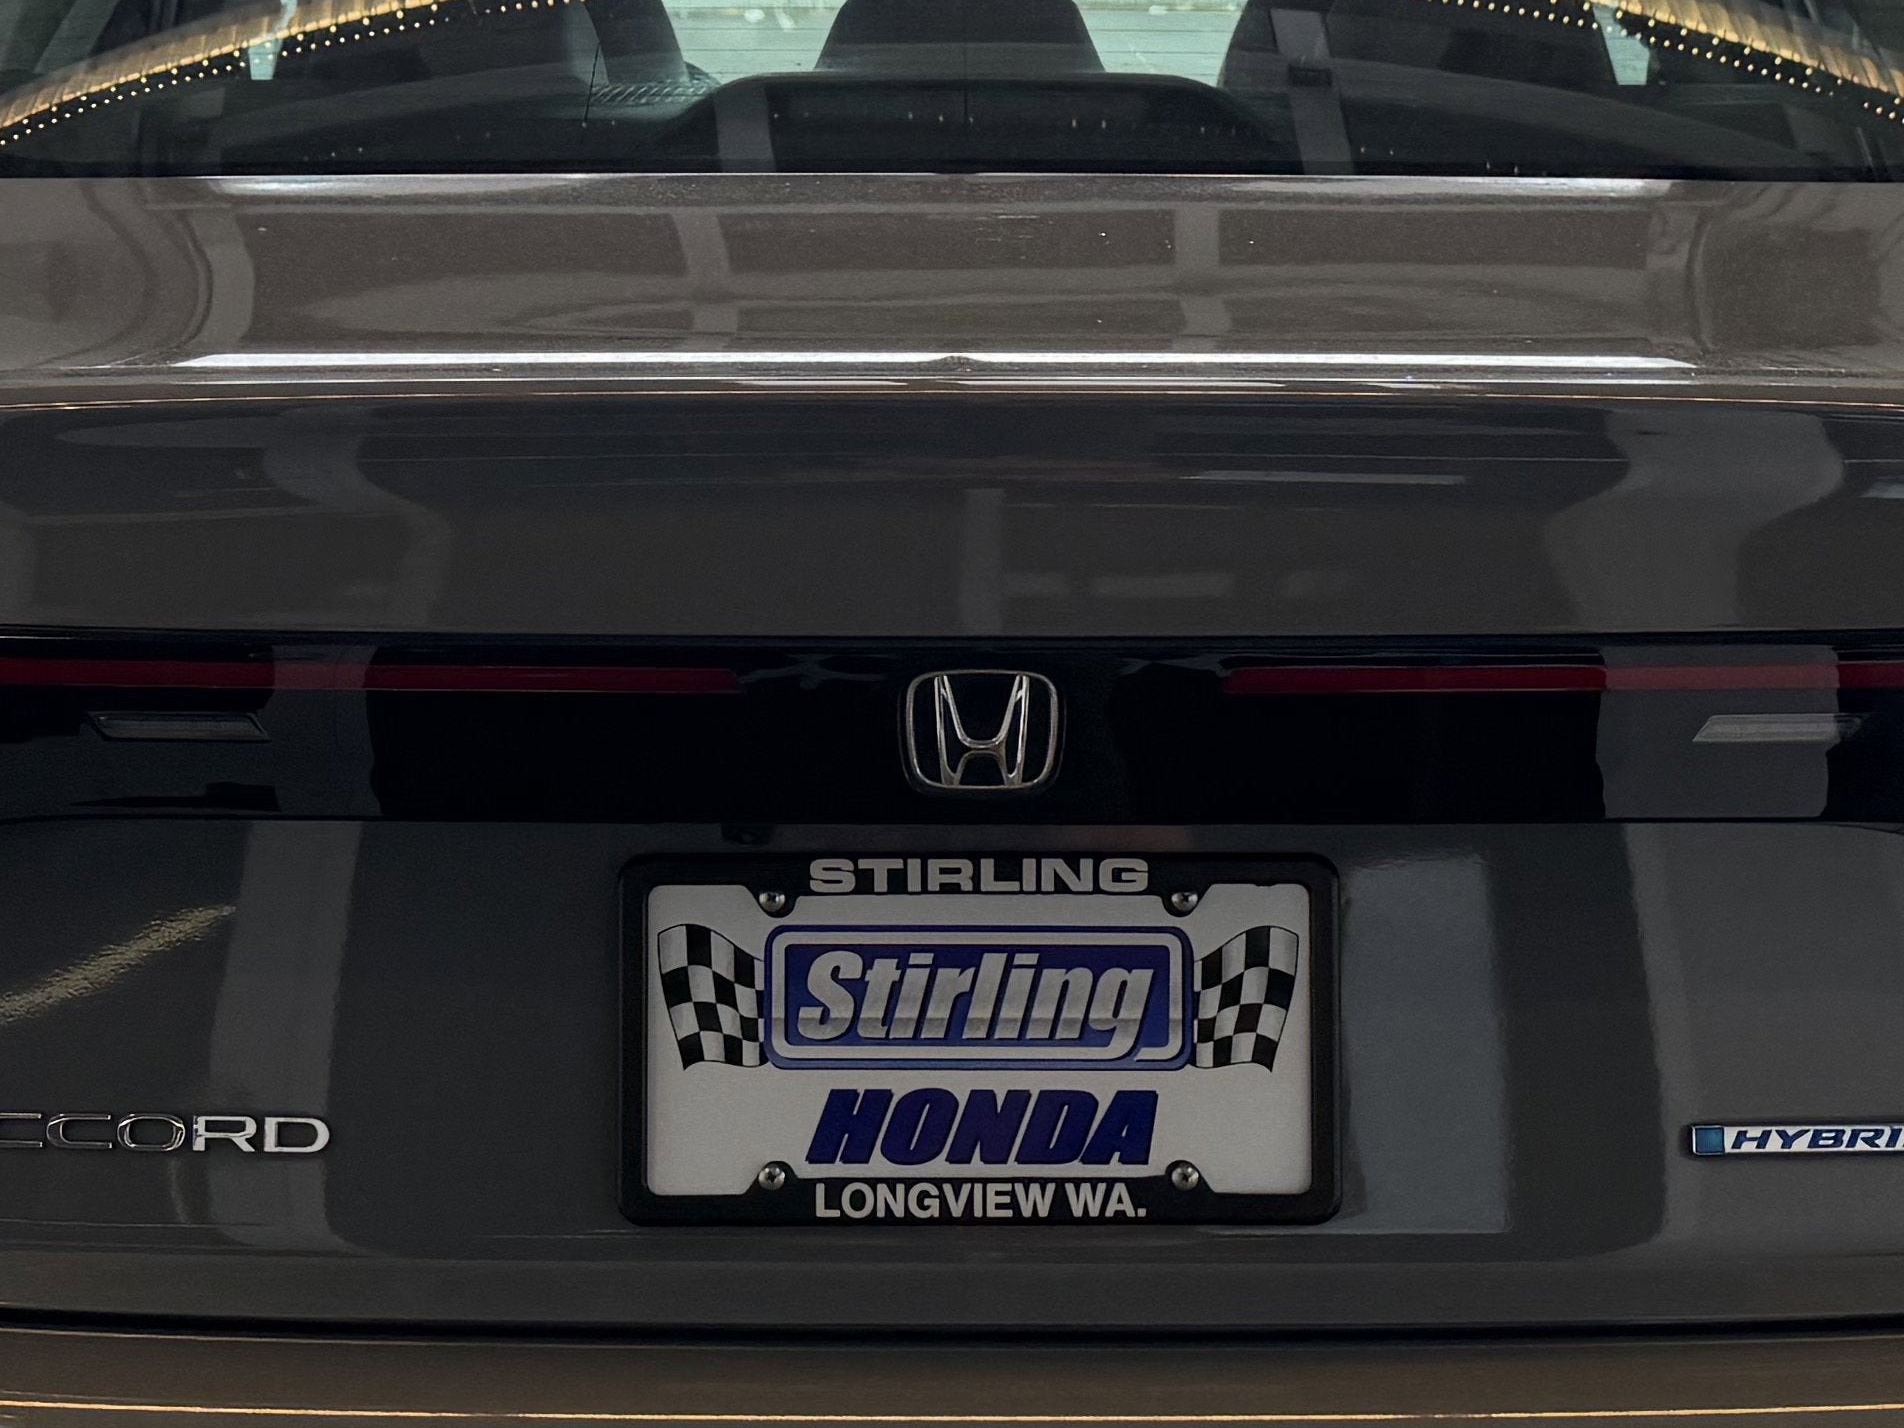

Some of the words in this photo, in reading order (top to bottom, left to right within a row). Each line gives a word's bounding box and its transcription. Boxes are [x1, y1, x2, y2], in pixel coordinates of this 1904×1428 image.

[808, 857, 1150, 894] STIRLING
[796, 949, 1155, 1061] Stirling
[804, 1088, 1159, 1166] HONDA
[814, 1181, 1063, 1219] LONGVIEW
[1065, 1181, 1148, 1218] WA.
